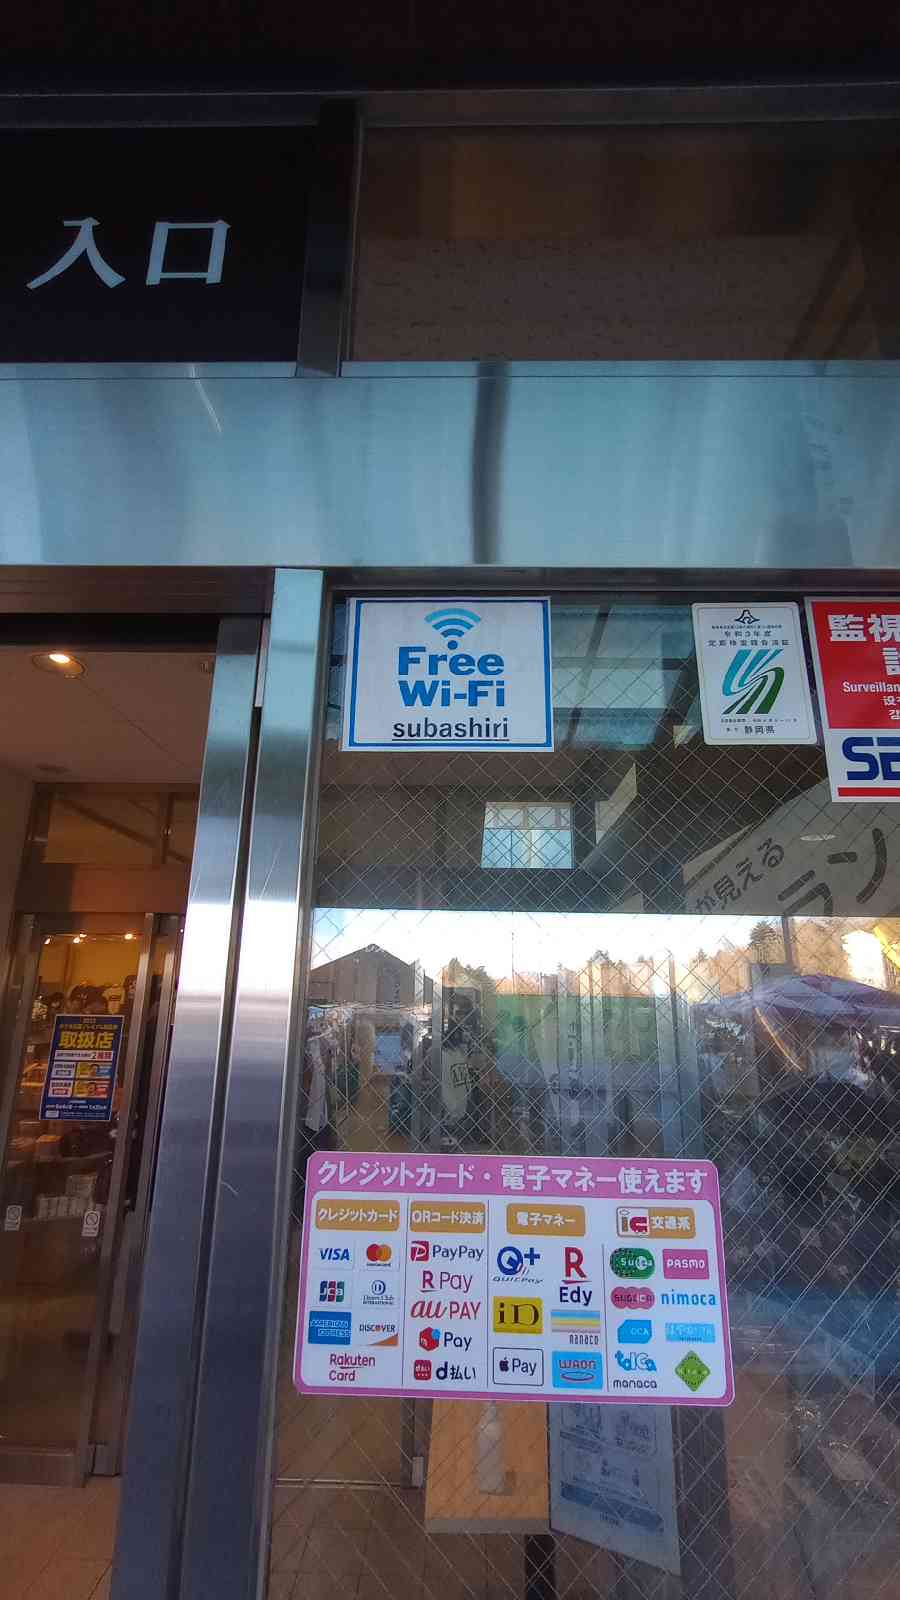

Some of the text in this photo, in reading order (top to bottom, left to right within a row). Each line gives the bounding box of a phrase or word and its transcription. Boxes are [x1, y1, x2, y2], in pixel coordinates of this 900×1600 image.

[26, 216, 231, 289] 入口
[398, 646, 505, 676] Free
[398, 680, 505, 707] Wi-Fi
[392, 717, 508, 738] subashiri
[318, 1160, 708, 1195] クレジットカード・電子マネー使えます
[318, 1208, 399, 1223] クレジットカード
[412, 1210, 484, 1225] QRコード決済
[516, 1211, 576, 1227] 電子マネー
[320, 1248, 350, 1260] VISA
[432, 1244, 484, 1261] PayPay
[564, 1246, 587, 1279] R
[439, 1271, 473, 1294] Pay
[559, 1286, 593, 1306] Edy
[661, 1289, 716, 1306] nimoca
[411, 1300, 448, 1319] au
[449, 1301, 481, 1320] PAY
[498, 1302, 540, 1326] iD
[360, 1324, 396, 1332] DISCOVER
[443, 1331, 472, 1352] Pay
[329, 1353, 376, 1367] Rakuten
[511, 1358, 537, 1377] Pay
[328, 1370, 356, 1382] Card
[436, 1361, 477, 1380] d払い
[613, 1379, 657, 1389] manaca
